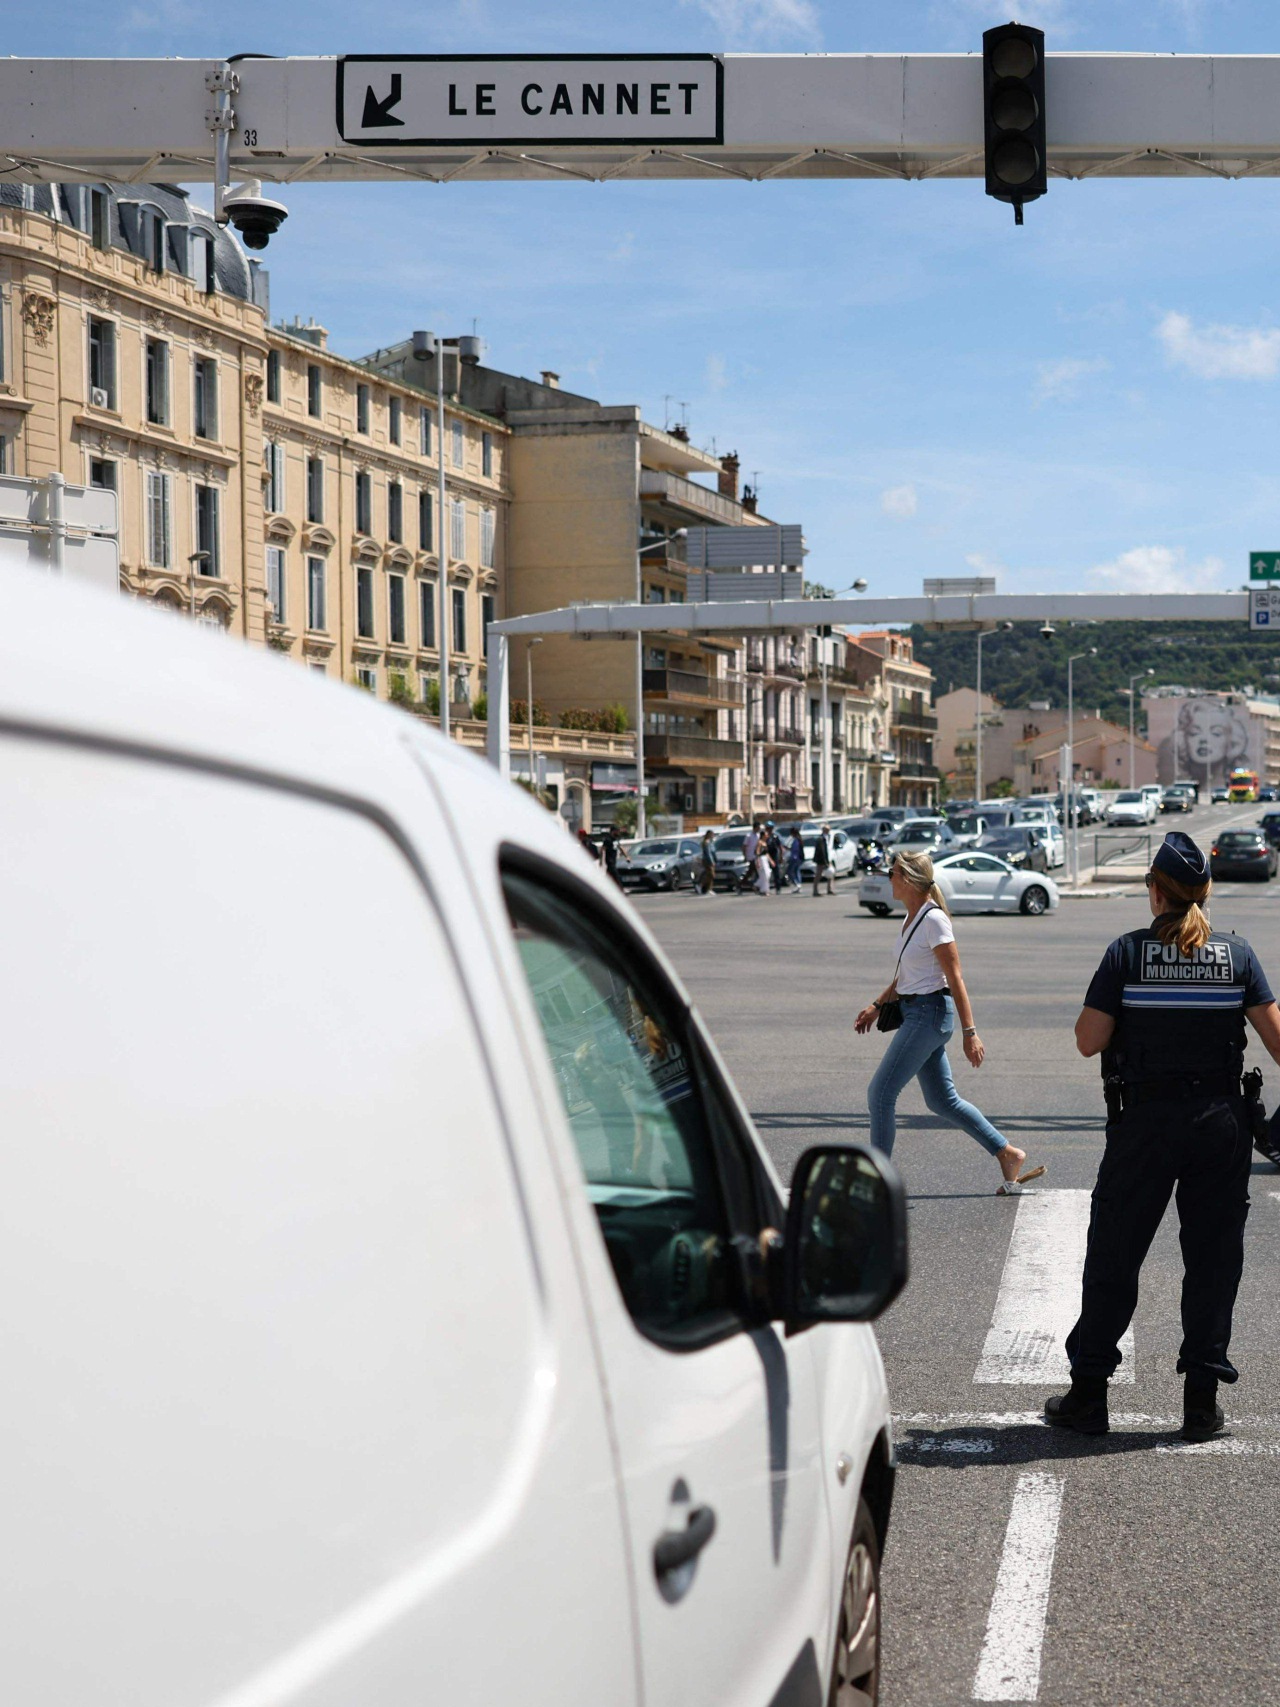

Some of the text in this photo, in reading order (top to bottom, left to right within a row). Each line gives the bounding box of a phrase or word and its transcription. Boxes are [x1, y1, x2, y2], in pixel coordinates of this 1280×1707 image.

[448, 83, 699, 116] LE CANNET
[244, 130, 258, 147] 33
[1146, 965, 1230, 980] MUNICIPALE
